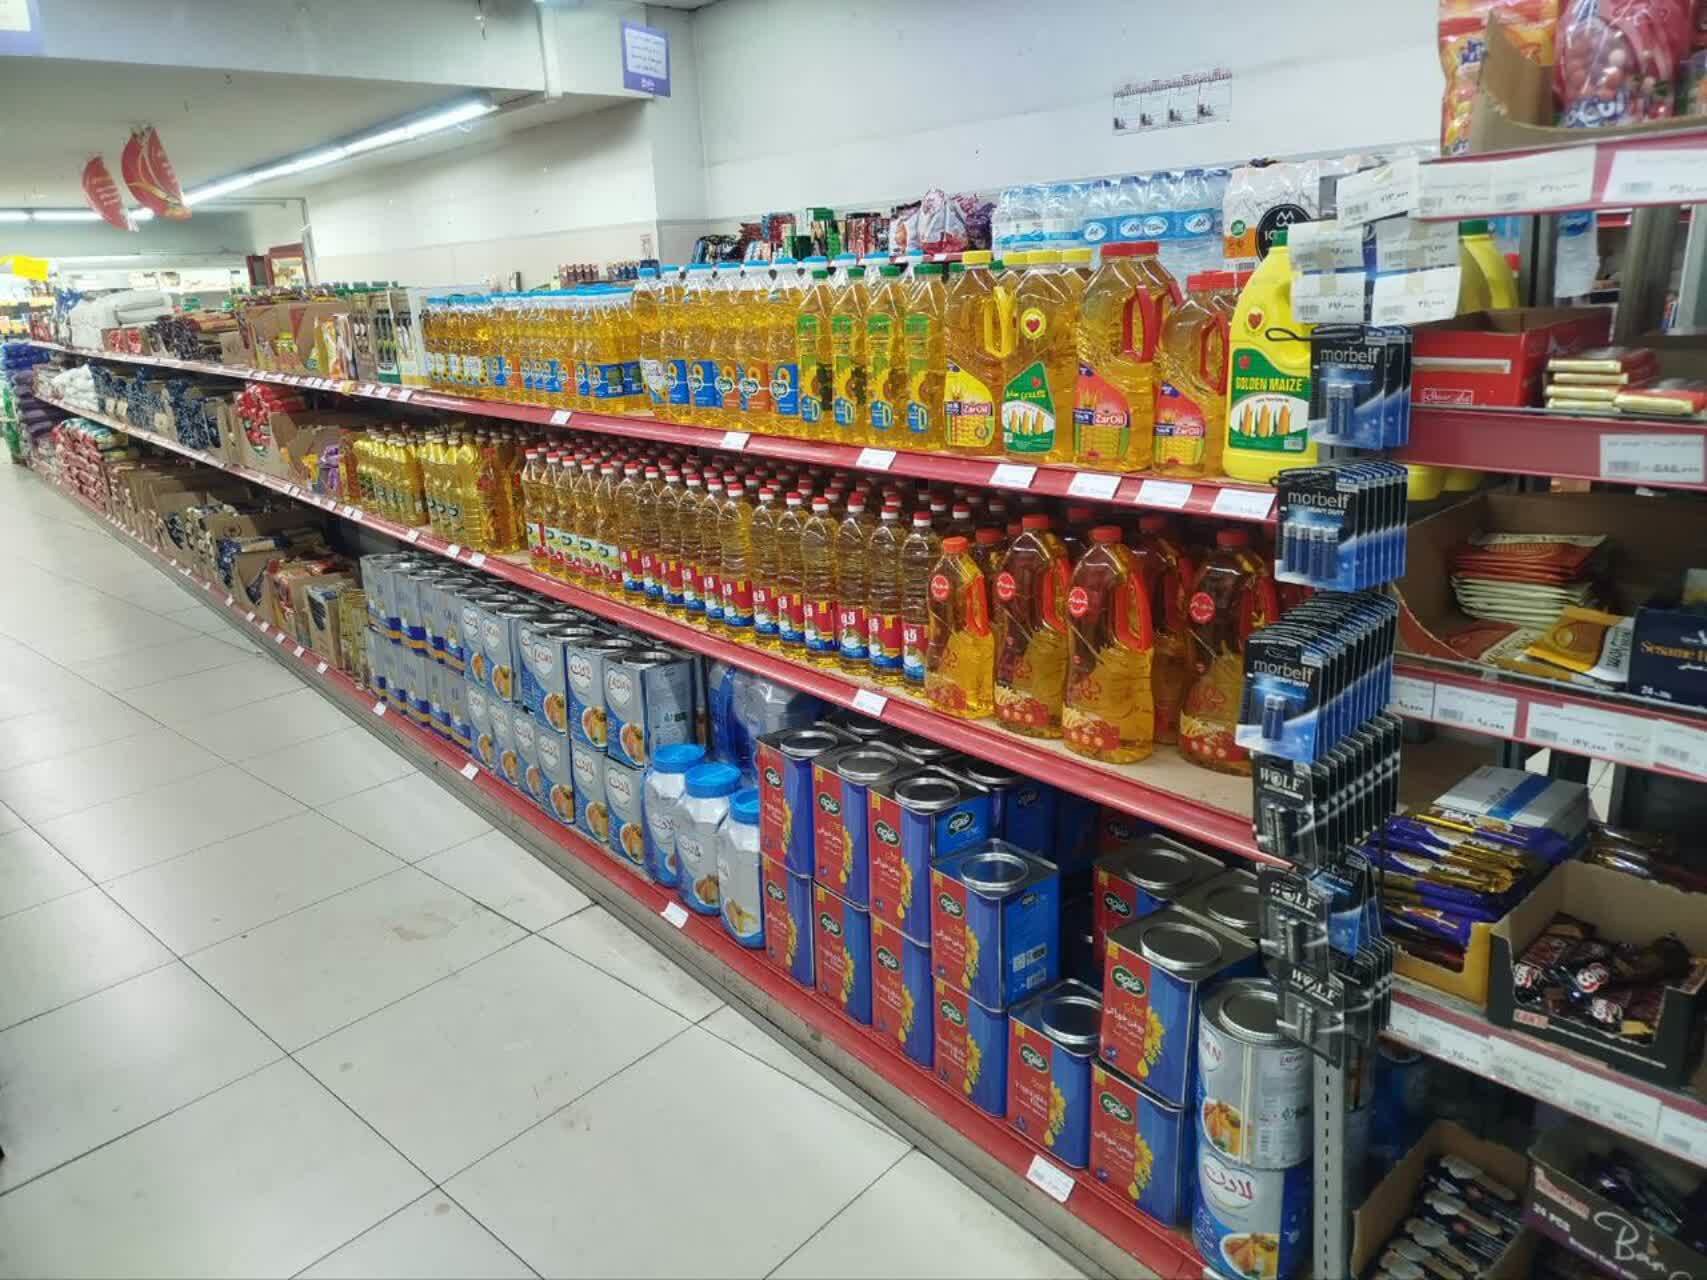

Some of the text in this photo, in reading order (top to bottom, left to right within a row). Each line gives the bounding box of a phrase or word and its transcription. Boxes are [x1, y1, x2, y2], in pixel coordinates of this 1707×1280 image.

[1319, 346, 1380, 364] morbelf
[1235, 376, 1303, 392] GOLDEN MAIZE
[1094, 414, 1124, 426] ZarOil
[1175, 425, 1201, 436] ZarOil
[1287, 490, 1350, 509] morbelf
[1253, 659, 1314, 682] morbelf
[1260, 767, 1304, 791] WOLF
[1205, 1166, 1254, 1200] لادن
